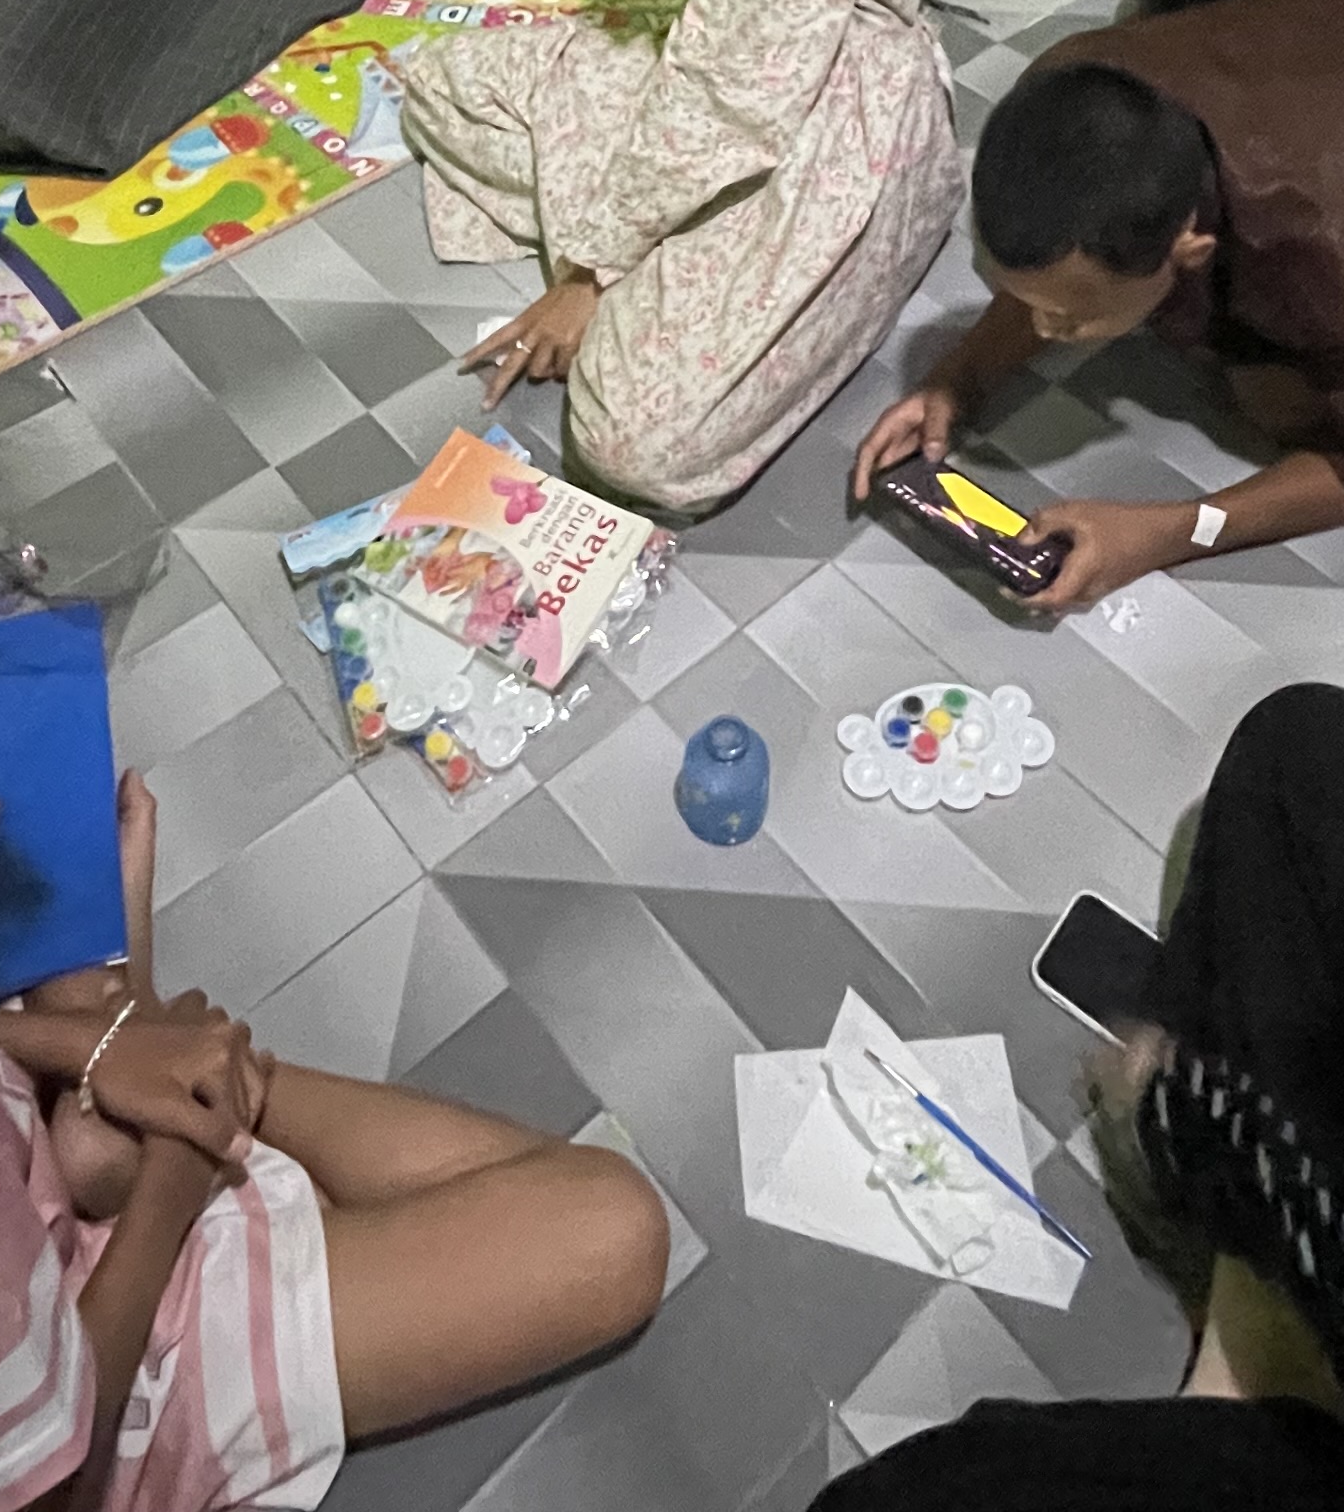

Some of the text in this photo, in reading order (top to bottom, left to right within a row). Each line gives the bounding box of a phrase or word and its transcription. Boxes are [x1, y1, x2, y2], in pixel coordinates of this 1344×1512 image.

[532, 503, 597, 576] Barang
[542, 495, 579, 544] dengan
[536, 514, 618, 617] Bekas
